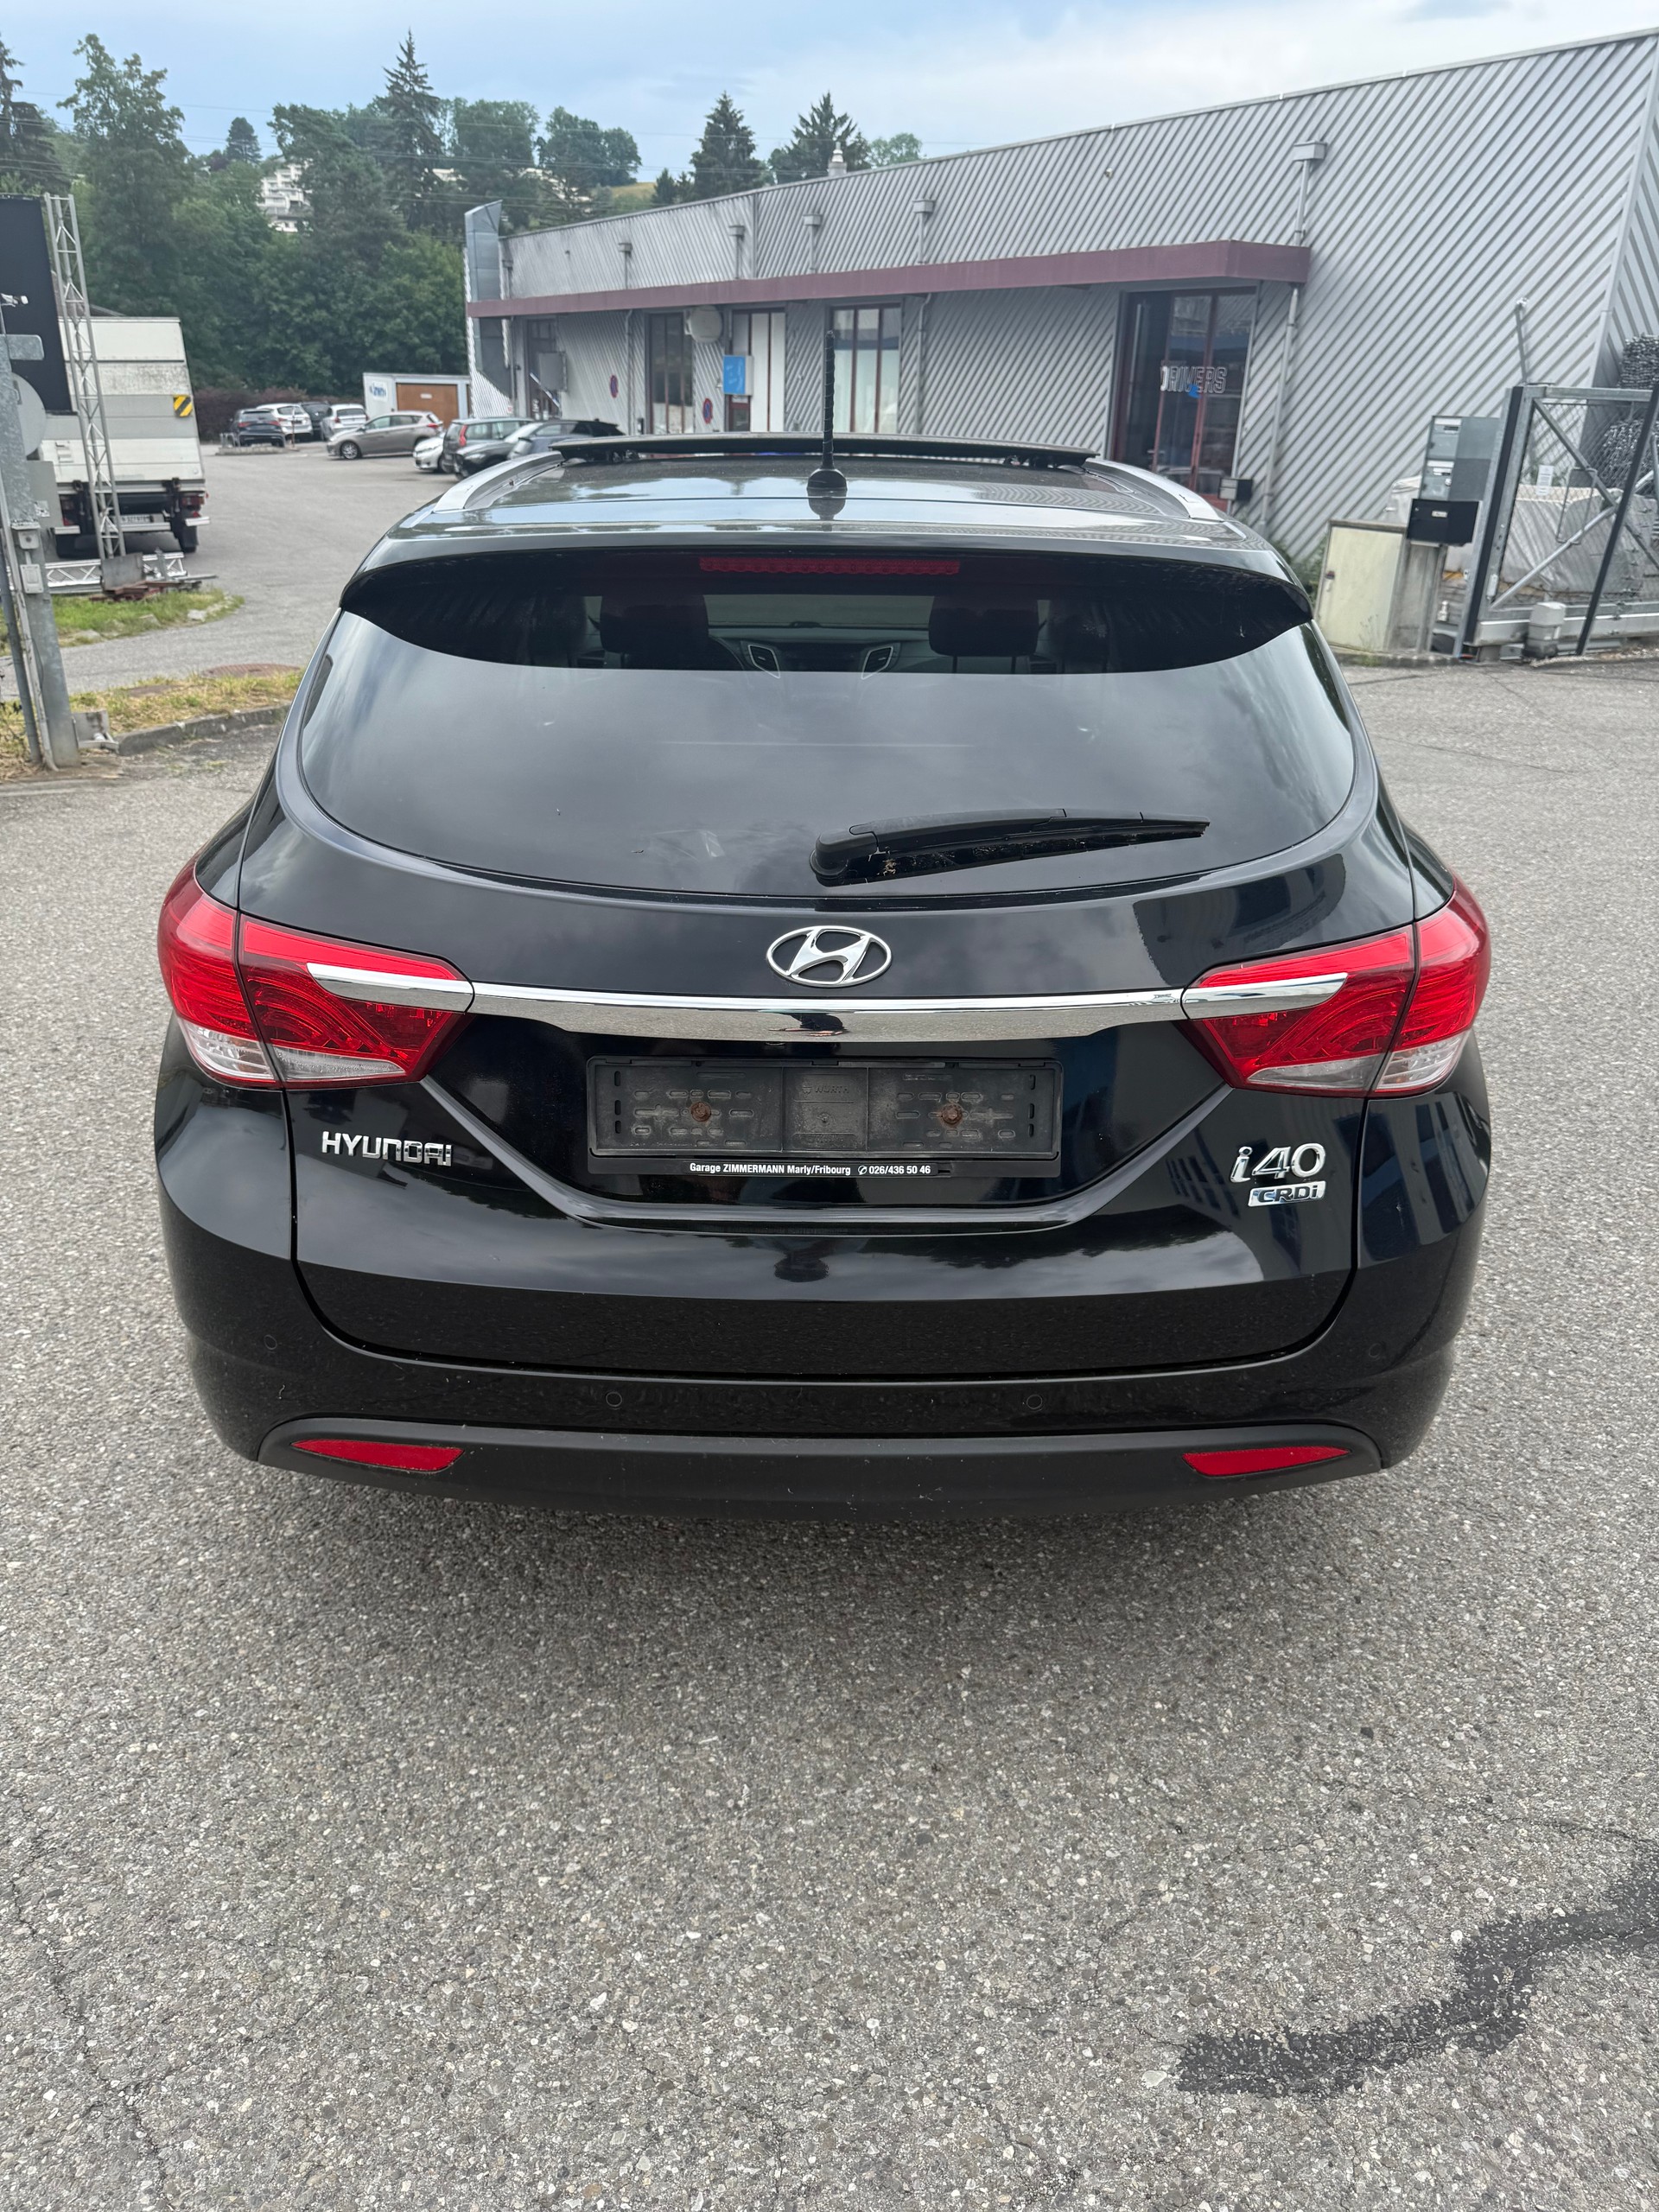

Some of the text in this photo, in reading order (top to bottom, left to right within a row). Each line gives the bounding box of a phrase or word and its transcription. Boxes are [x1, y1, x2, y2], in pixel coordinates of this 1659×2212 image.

[321, 1131, 452, 1166] HYUNDAI
[690, 1162, 931, 1176] Garage ZIMMERMANN Marly/Fribourg 026/436 50 46
[1230, 1143, 1326, 1183] i40
[1257, 1185, 1319, 1203] CRDi
